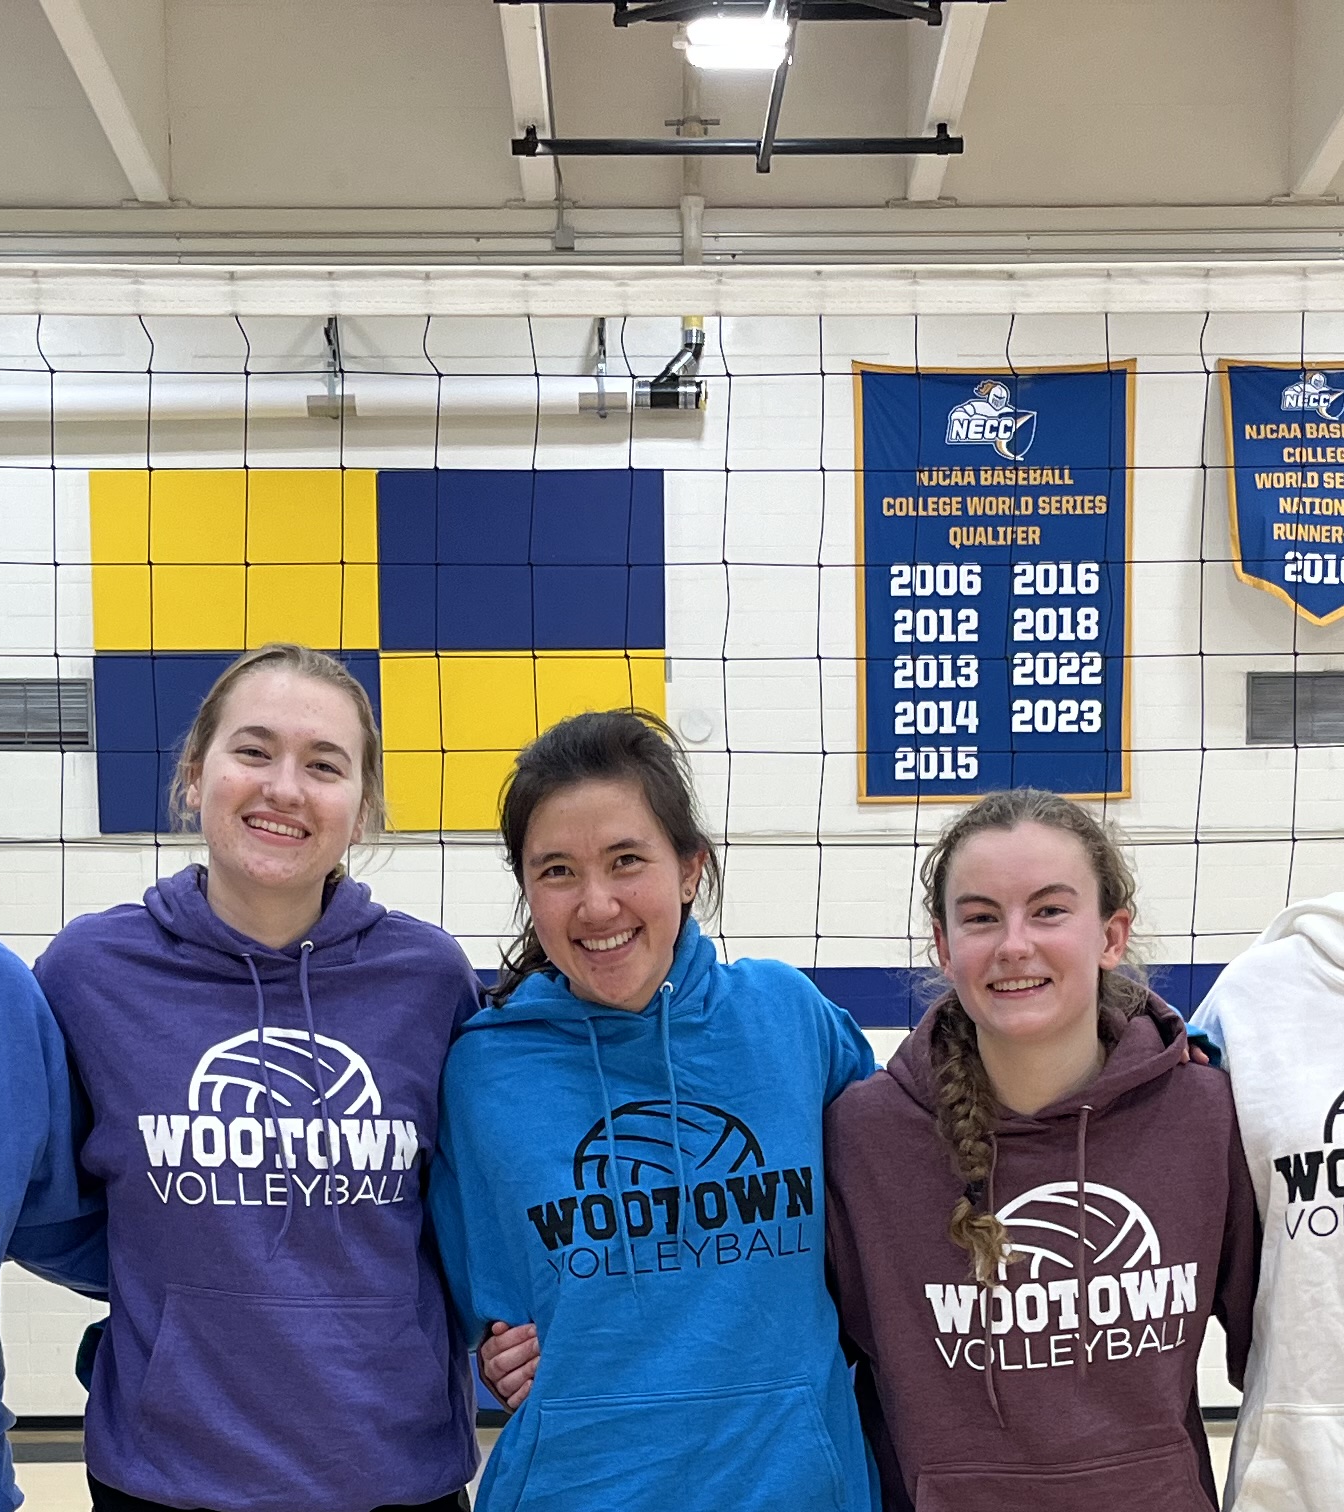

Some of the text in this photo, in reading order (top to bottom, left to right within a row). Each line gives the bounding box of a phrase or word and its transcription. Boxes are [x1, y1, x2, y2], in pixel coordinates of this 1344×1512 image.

[1285, 393, 1331, 409] NECC
[950, 418, 1015, 441] NECC
[1244, 423, 1302, 440] NJCAA
[915, 465, 1074, 487] NJCAA BASEBALL
[1254, 471, 1319, 490] WORLD
[882, 494, 1107, 517] COLLEGE WORLD SERIES
[889, 561, 1099, 598] 2006 2016
[893, 606, 1099, 643] 2012 2018
[893, 651, 1103, 689] 2013 2022
[893, 699, 1102, 735] 2014 2023
[893, 746, 979, 781] 2015
[137, 1114, 419, 1171] WOOTOWN
[146, 1171, 405, 1207] VOLLEYBALL
[526, 1166, 813, 1252] WOOTOWN
[546, 1222, 811, 1284] VOLLEYBALL
[923, 1261, 1198, 1335] WOOTOWN
[934, 1317, 1186, 1371] VOLLEYBALL
